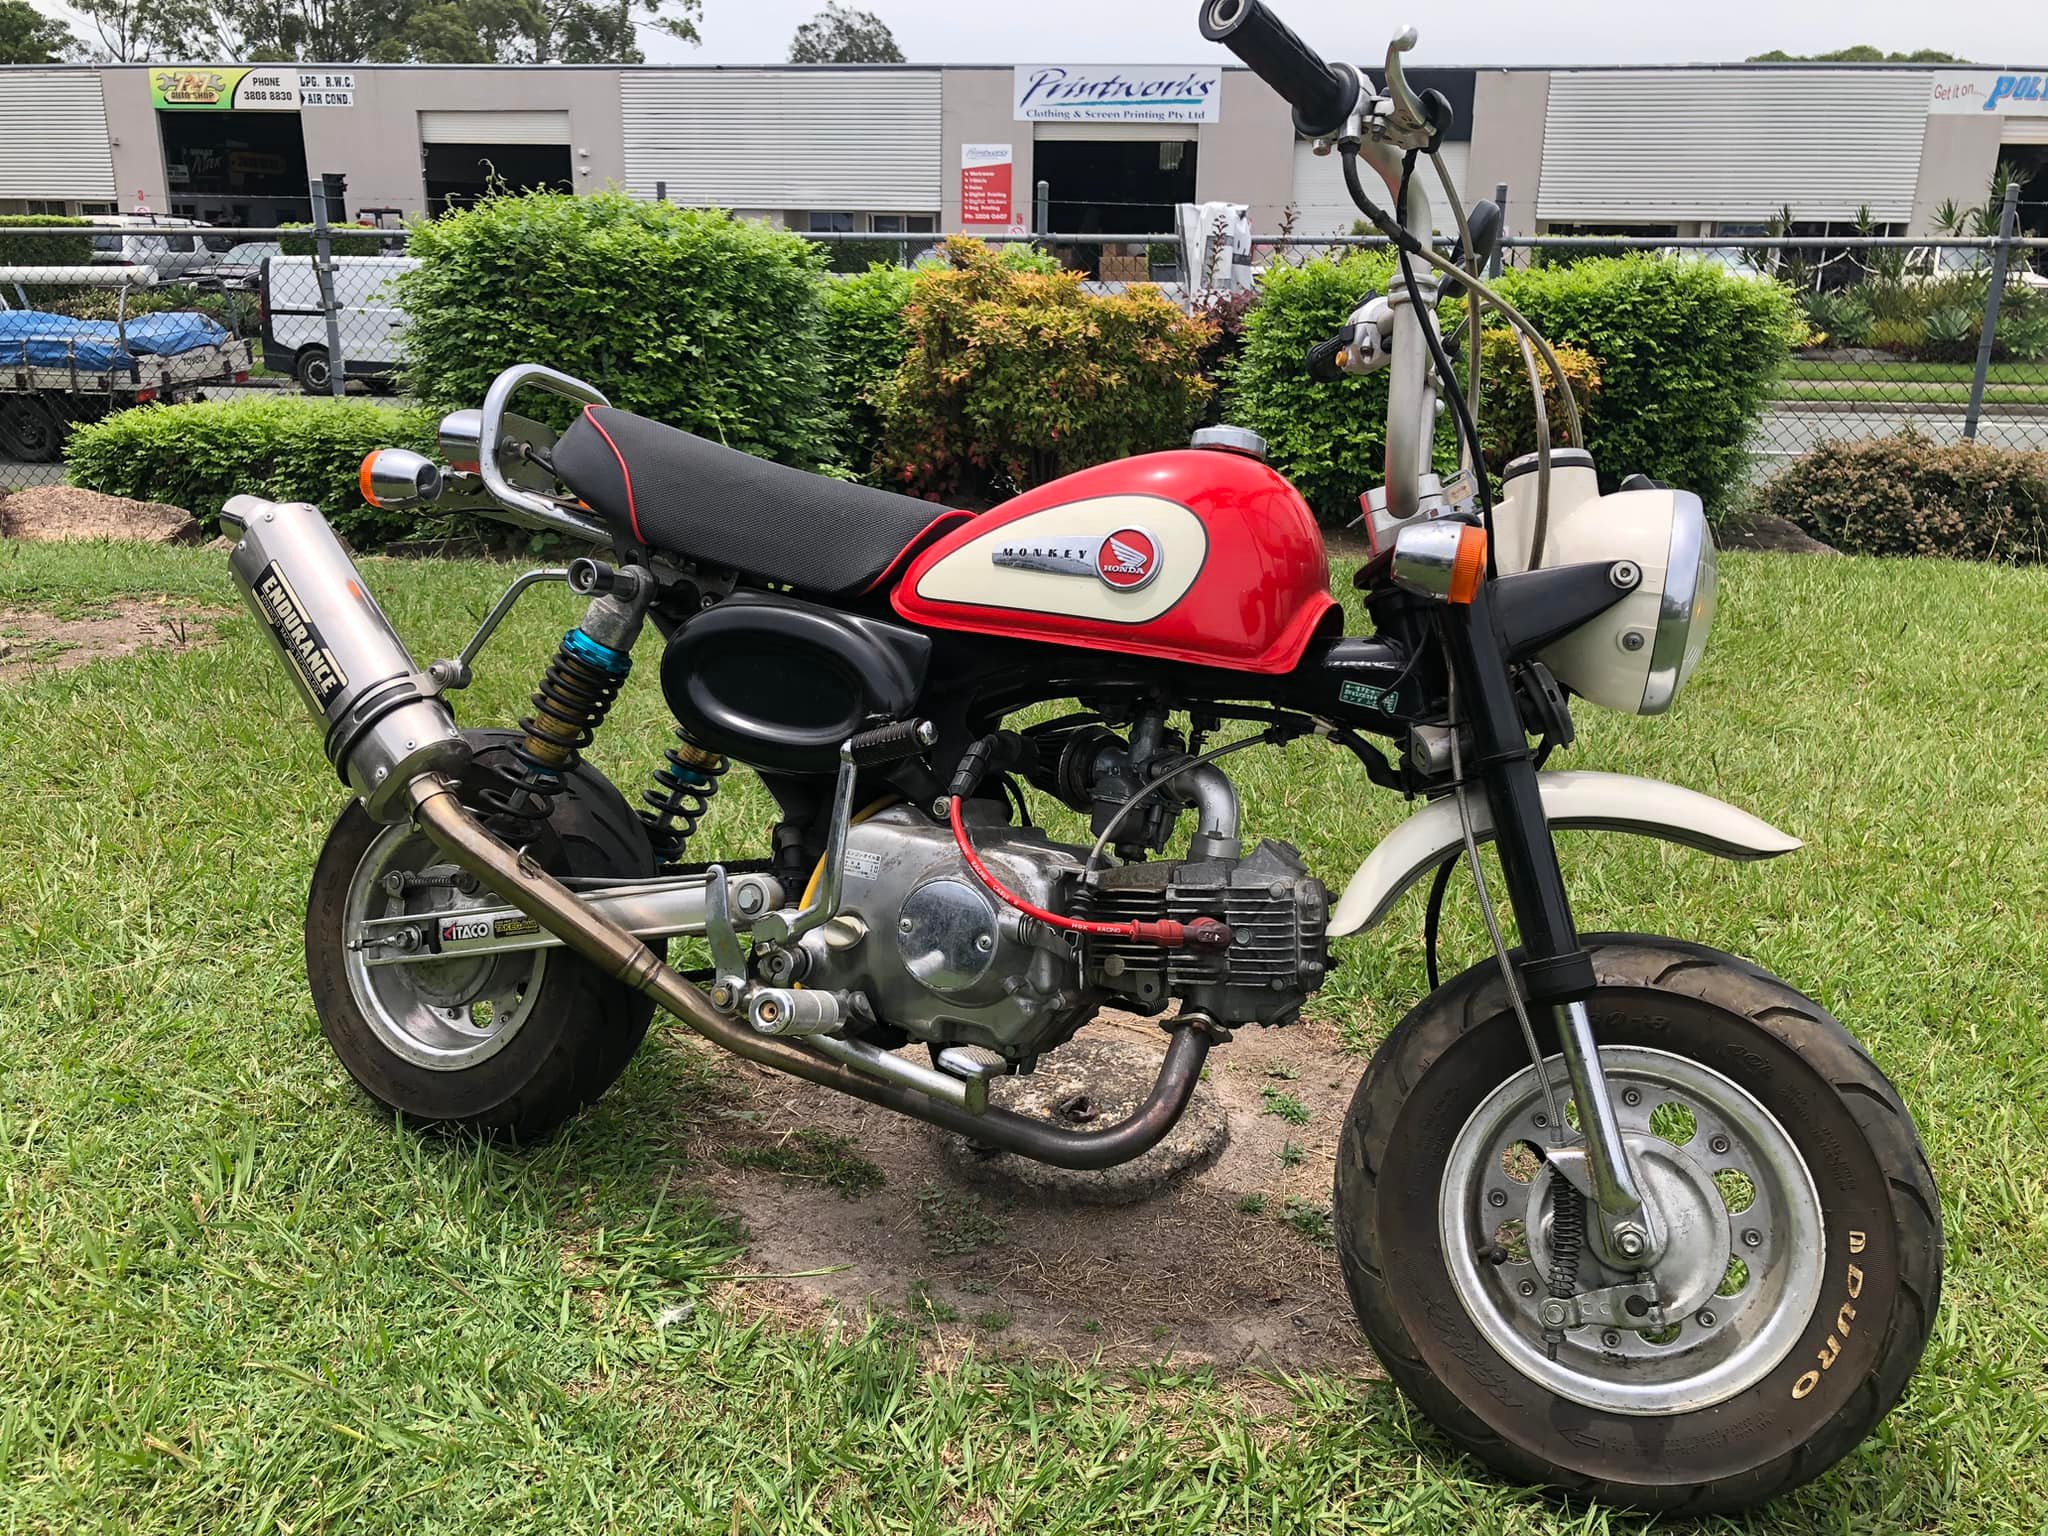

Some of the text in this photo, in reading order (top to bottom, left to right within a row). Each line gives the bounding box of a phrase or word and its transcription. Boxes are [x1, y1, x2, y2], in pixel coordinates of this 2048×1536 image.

[252, 77, 281, 86] PHONE
[299, 76, 354, 88] LPG. R.W.C.
[1019, 68, 1216, 107] Printworks
[243, 91, 292, 100] 3808 8830
[1934, 84, 1951, 100] Get
[1952, 84, 1959, 99] it
[1983, 76, 2048, 111] POL
[307, 93, 352, 104] AIR COND.
[1026, 109, 1205, 121] Clothing & Screen Printing Pty Ltd
[1002, 548, 1088, 559] MONKEY
[1103, 564, 1145, 575] HONDA
[261, 575, 338, 694] ENDURANCE
[1096, 925, 1121, 934] RACING
[1791, 1263, 1864, 1400] DURO
